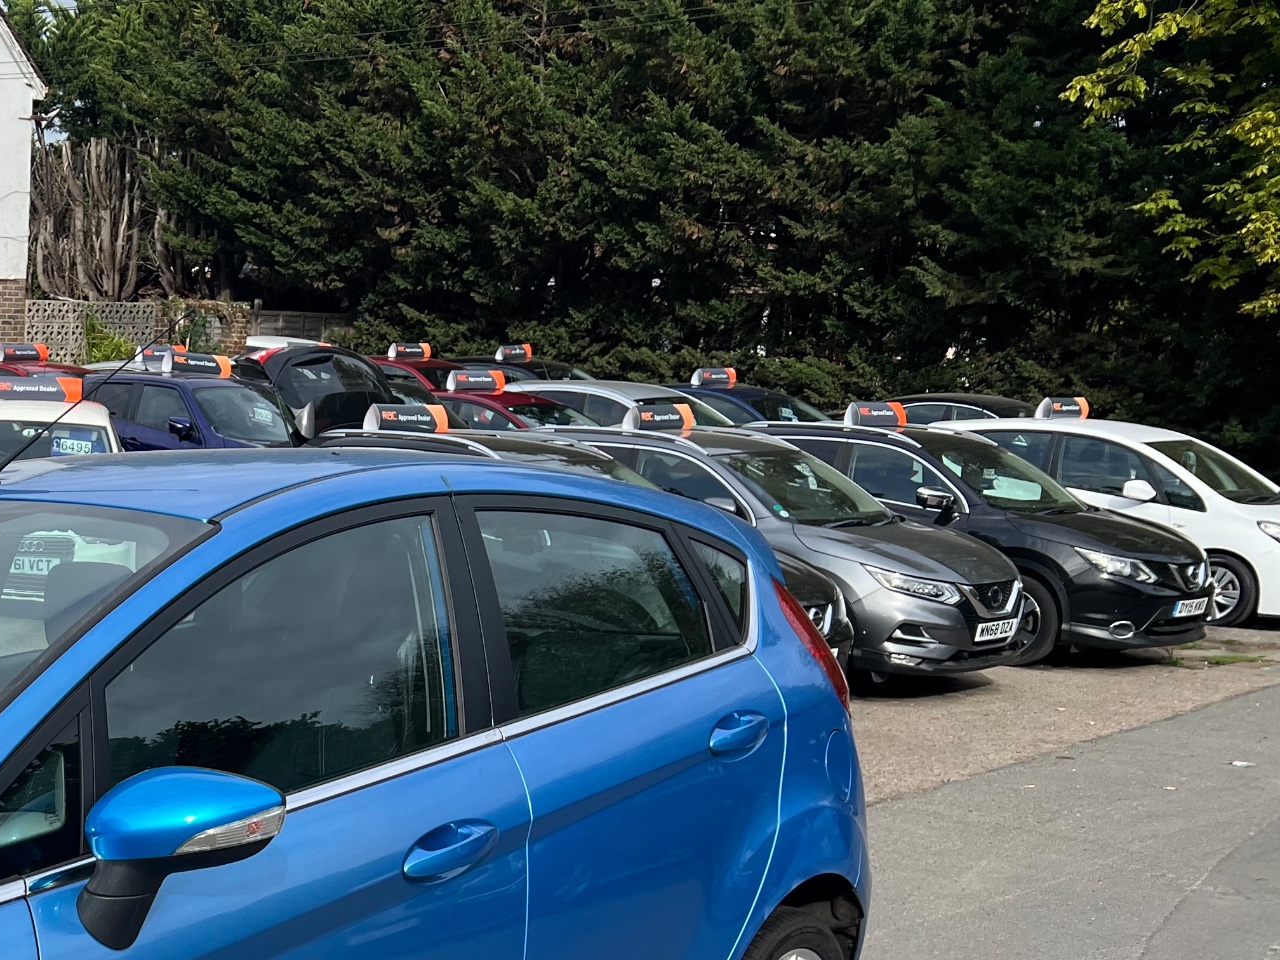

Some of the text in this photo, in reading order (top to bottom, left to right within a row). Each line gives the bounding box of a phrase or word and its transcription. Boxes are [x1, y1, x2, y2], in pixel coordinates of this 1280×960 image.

[28, 559, 53, 572] VCT
[979, 620, 1014, 638] WN68 DZA
